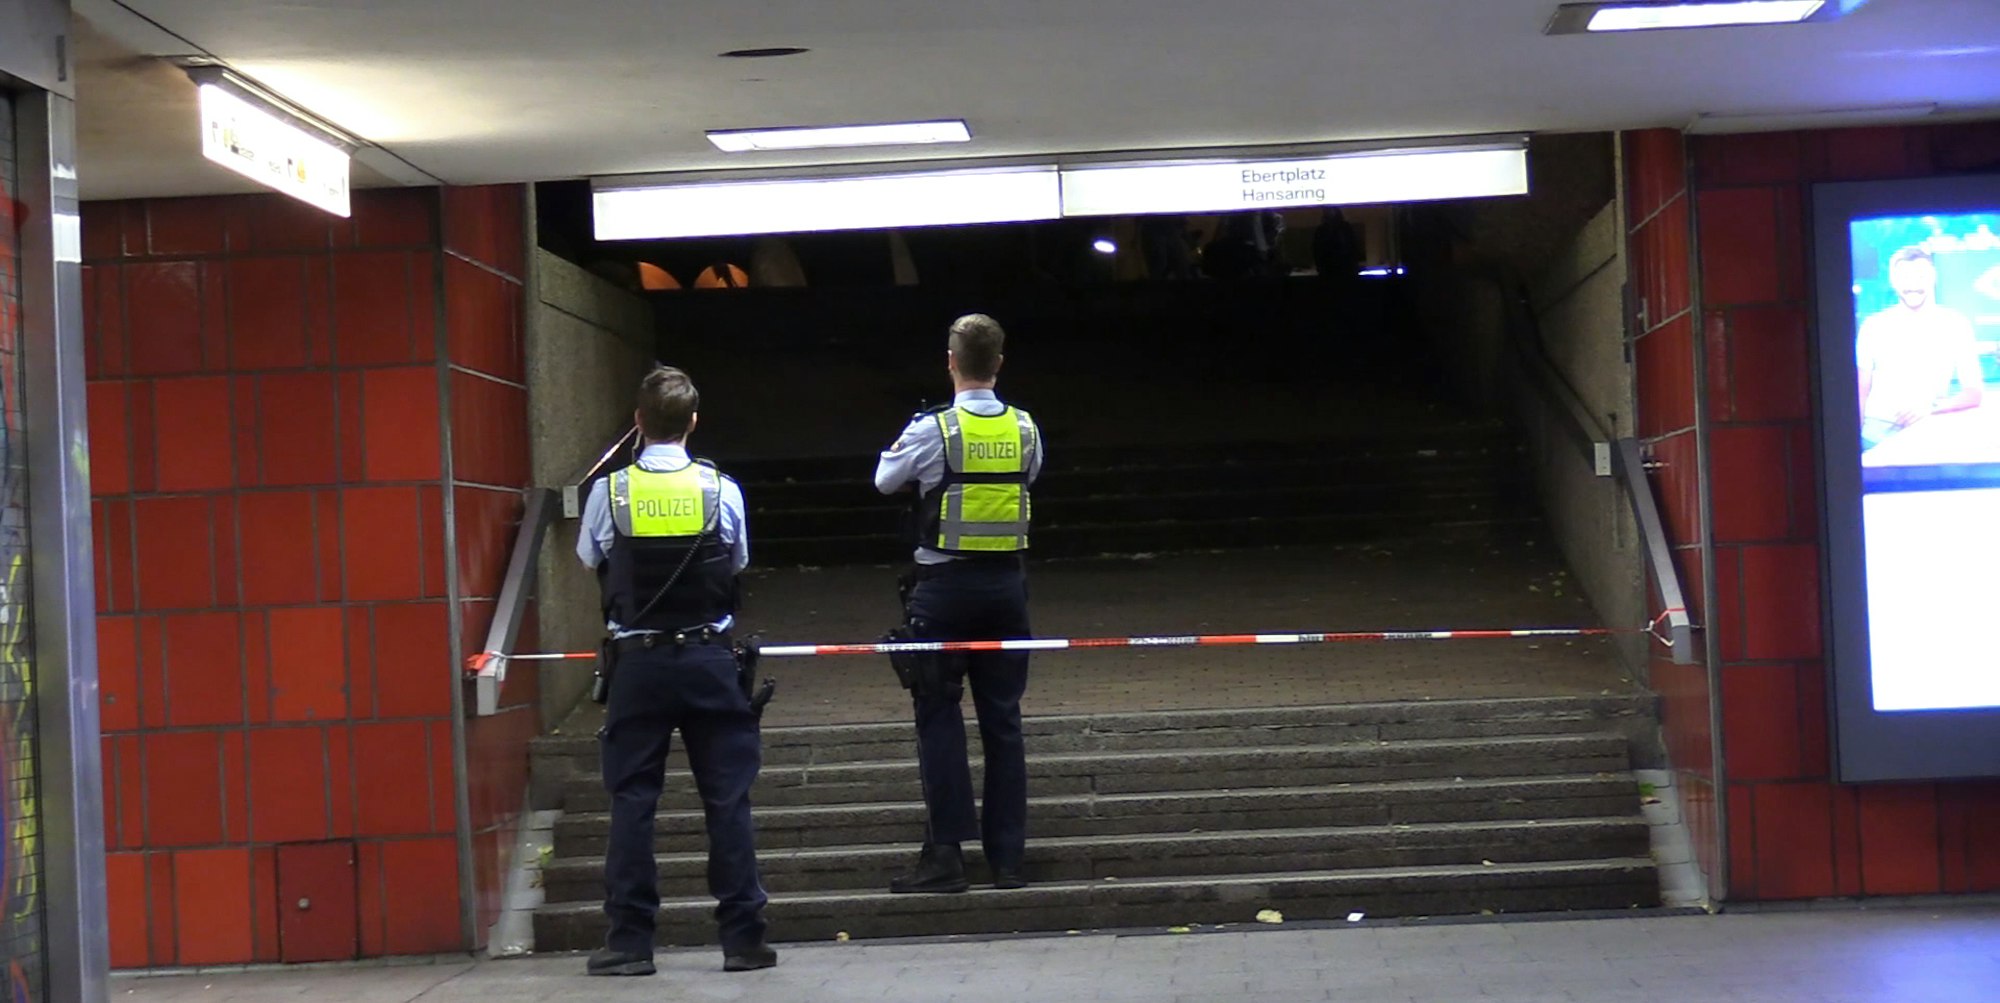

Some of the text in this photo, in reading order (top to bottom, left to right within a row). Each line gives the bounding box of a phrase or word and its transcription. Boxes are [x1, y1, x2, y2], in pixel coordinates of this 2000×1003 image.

[1241, 167, 1326, 184] Ebertplatz
[1242, 187, 1326, 202] Hansaring
[967, 441, 1017, 460] POLIZEI
[636, 497, 697, 518] POLIZEI
